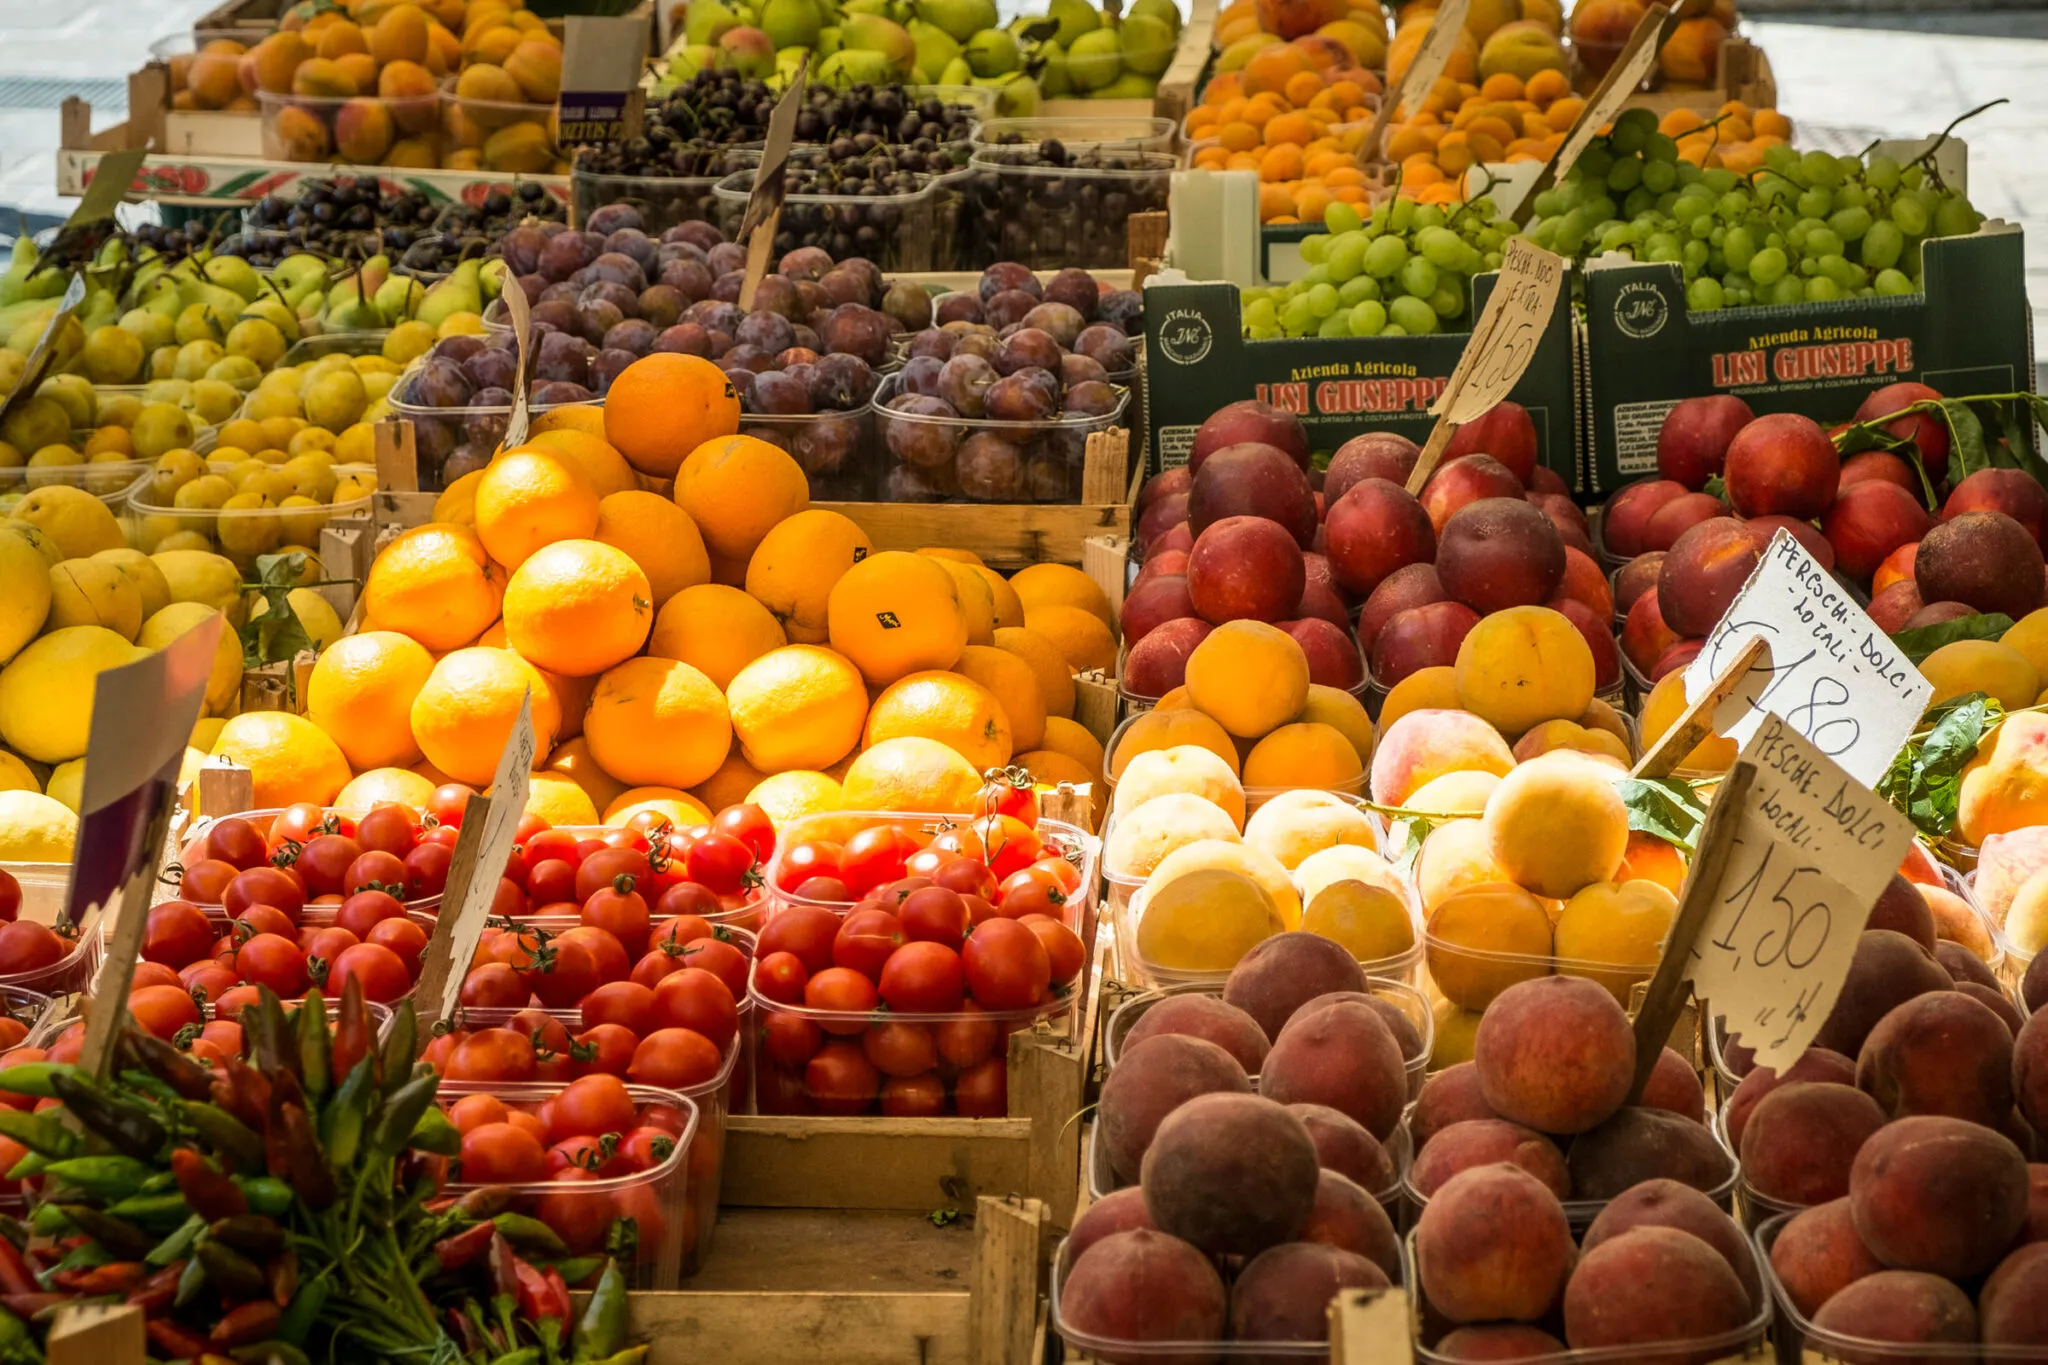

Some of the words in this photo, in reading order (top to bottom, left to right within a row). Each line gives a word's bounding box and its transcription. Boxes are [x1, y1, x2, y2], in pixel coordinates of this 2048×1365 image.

[1620, 282, 1658, 296] ITALIA
[1165, 309, 1202, 321] ITALIA
[1749, 329, 1809, 350] Azienda
[1813, 326, 1878, 342] Agricola
[1291, 362, 1349, 381] Azienda
[1354, 361, 1417, 377] Agricola
[1712, 351, 1768, 387] LISI
[1774, 338, 1913, 382] GIUSEPPE
